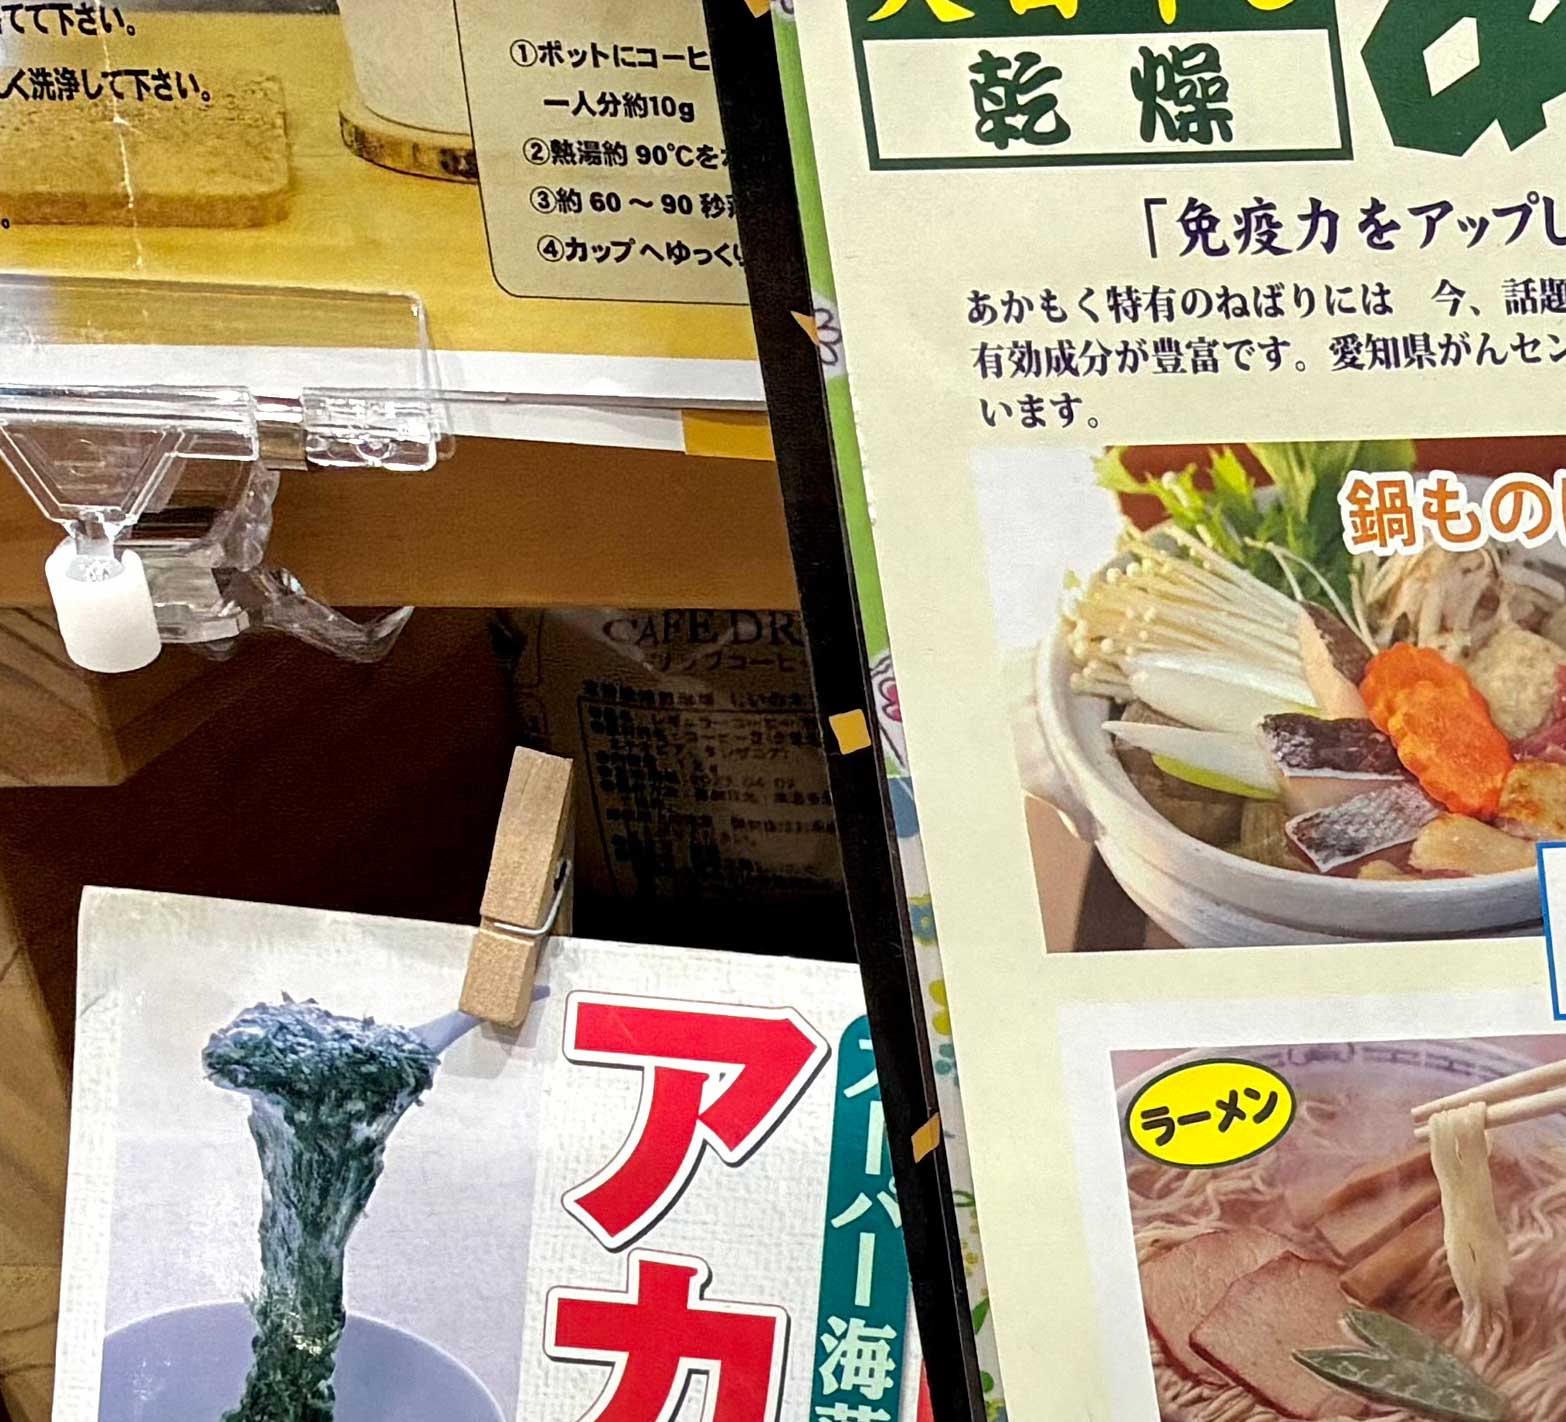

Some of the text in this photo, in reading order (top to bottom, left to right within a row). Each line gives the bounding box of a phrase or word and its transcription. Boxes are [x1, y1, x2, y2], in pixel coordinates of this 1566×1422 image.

[0, 68, 211, 101] く洗浄して下さい。
[969, 42, 1235, 149] 乾燥
[543, 91, 695, 123] 一人分約10g
[635, 142, 729, 170] 90℃を
[589, 191, 622, 213] 60
[660, 193, 693, 215] 90
[981, 394, 1101, 430] います。
[1139, 1080, 1284, 1142] ラーメン
